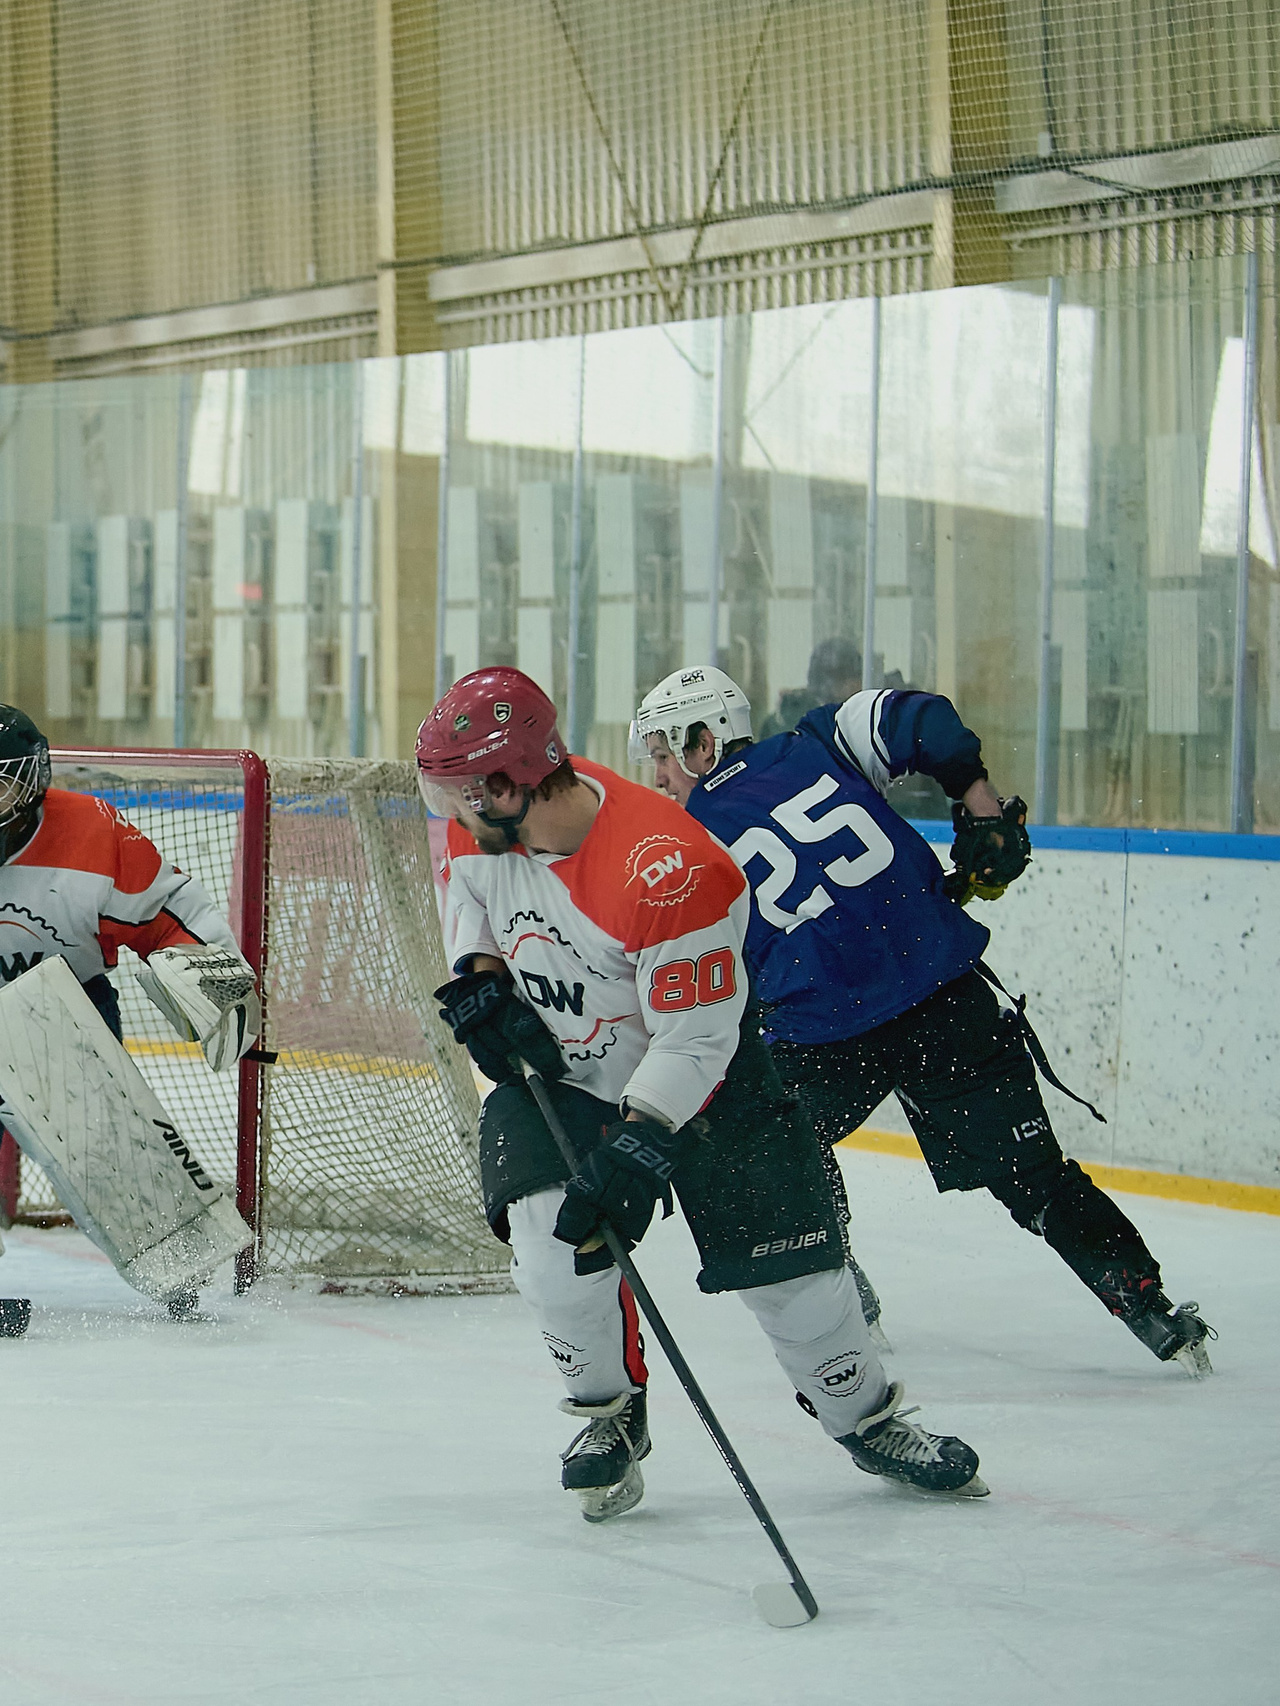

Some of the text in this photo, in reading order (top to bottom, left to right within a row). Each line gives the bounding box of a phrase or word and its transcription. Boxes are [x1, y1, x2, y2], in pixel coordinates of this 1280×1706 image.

[640, 850, 684, 889] DW
[728, 773, 895, 935] 25
[519, 969, 585, 1016] DW
[648, 946, 738, 1014] 80
[751, 1229, 828, 1258] BAUER
[823, 1362, 856, 1387] DW
